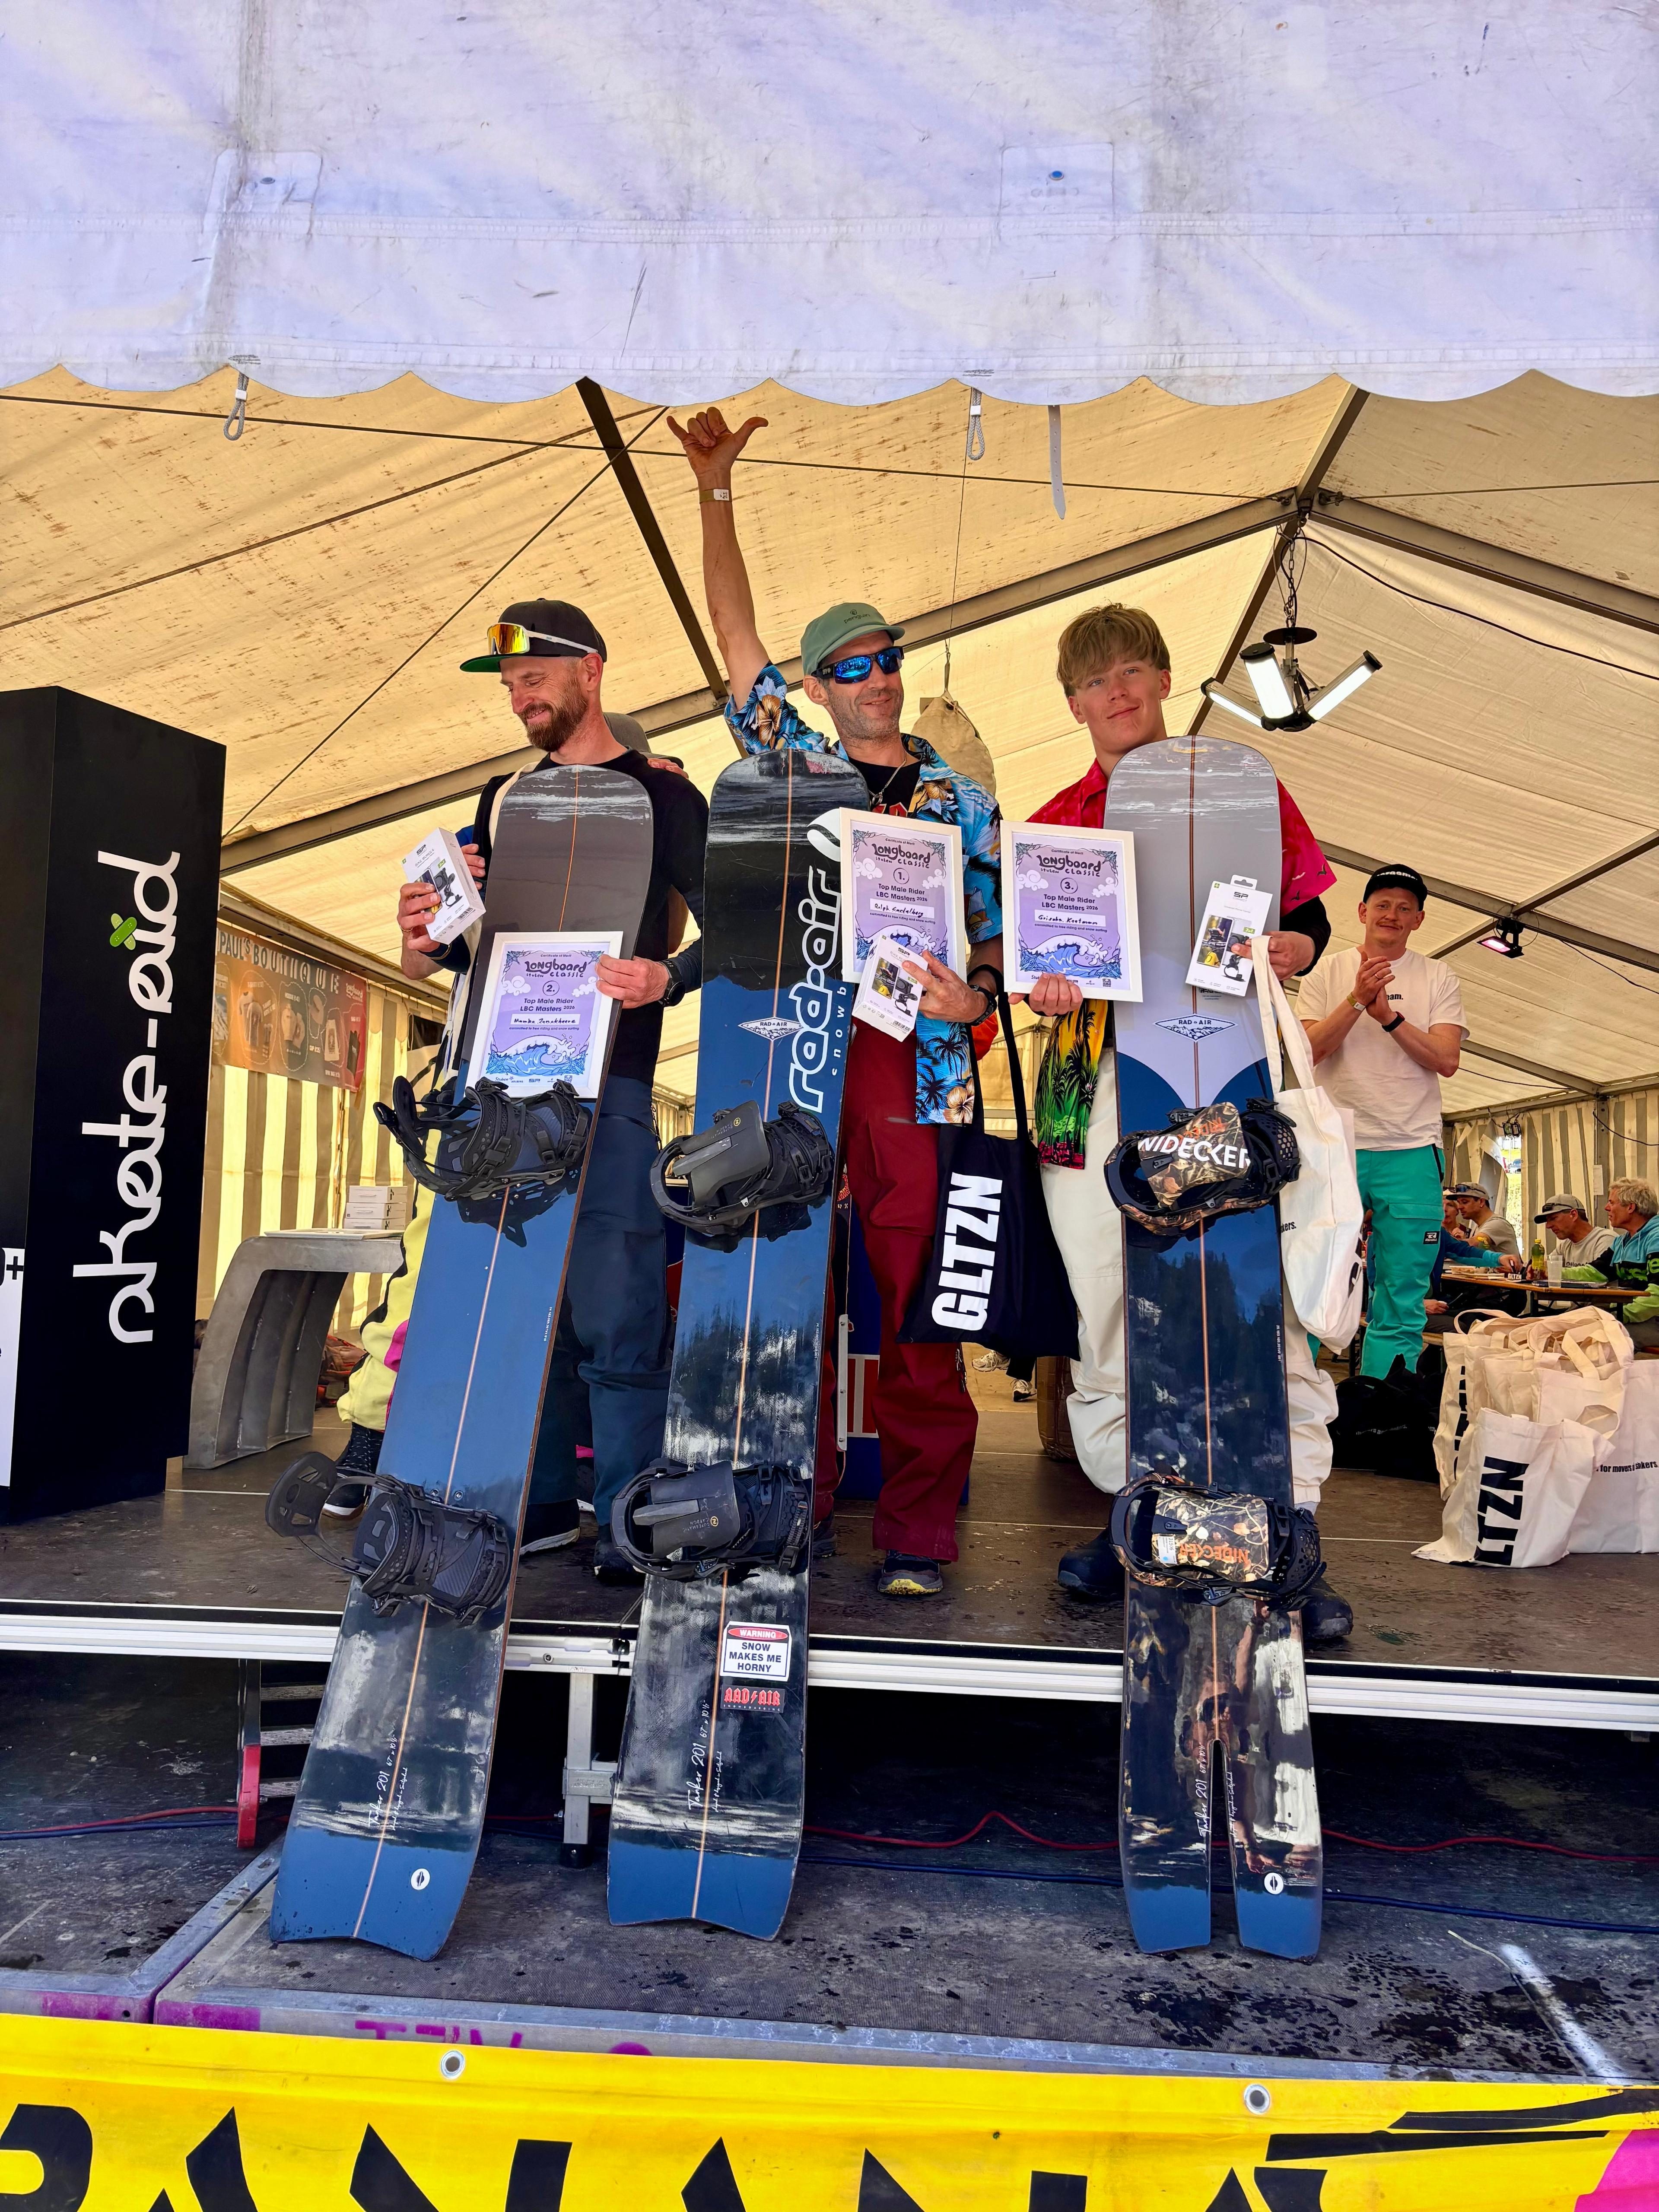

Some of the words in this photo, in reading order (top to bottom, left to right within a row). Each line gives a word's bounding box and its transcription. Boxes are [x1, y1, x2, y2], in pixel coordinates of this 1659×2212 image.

[891, 893, 915, 902] Masters
[931, 1172, 1002, 1331] GLTZN
[1600, 1464, 1611, 1472] for
[1474, 1455, 1530, 1566] LTZN
[740, 1629, 776, 1639] WARNING
[741, 1642, 771, 1652] SNOW
[729, 1652, 763, 1662] MAKES
[766, 1654, 782, 1663] ME
[737, 1662, 772, 1672] HORNY
[691, 1742, 706, 1767] 201
